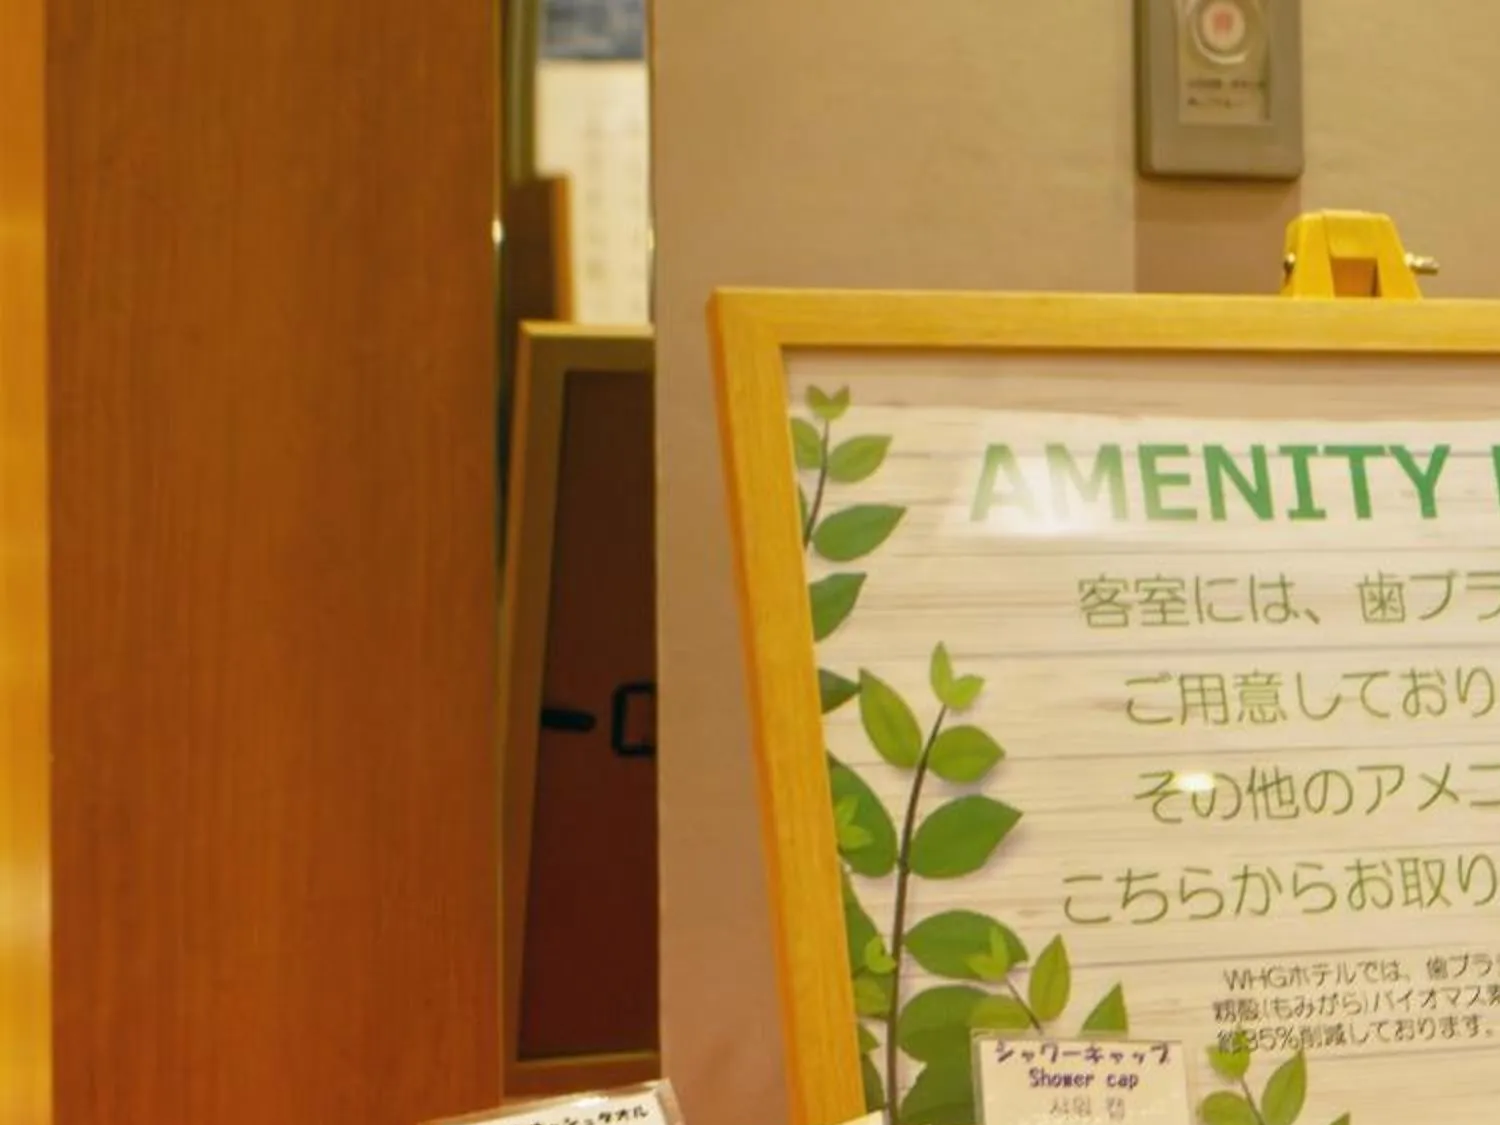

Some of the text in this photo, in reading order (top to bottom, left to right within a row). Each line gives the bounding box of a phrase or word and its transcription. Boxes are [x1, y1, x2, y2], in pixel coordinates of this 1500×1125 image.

[969, 443, 1450, 521] AMENITY
[996, 1040, 1170, 1064] シャワーキャップ
[1029, 1069, 1139, 1090] Shower cap
